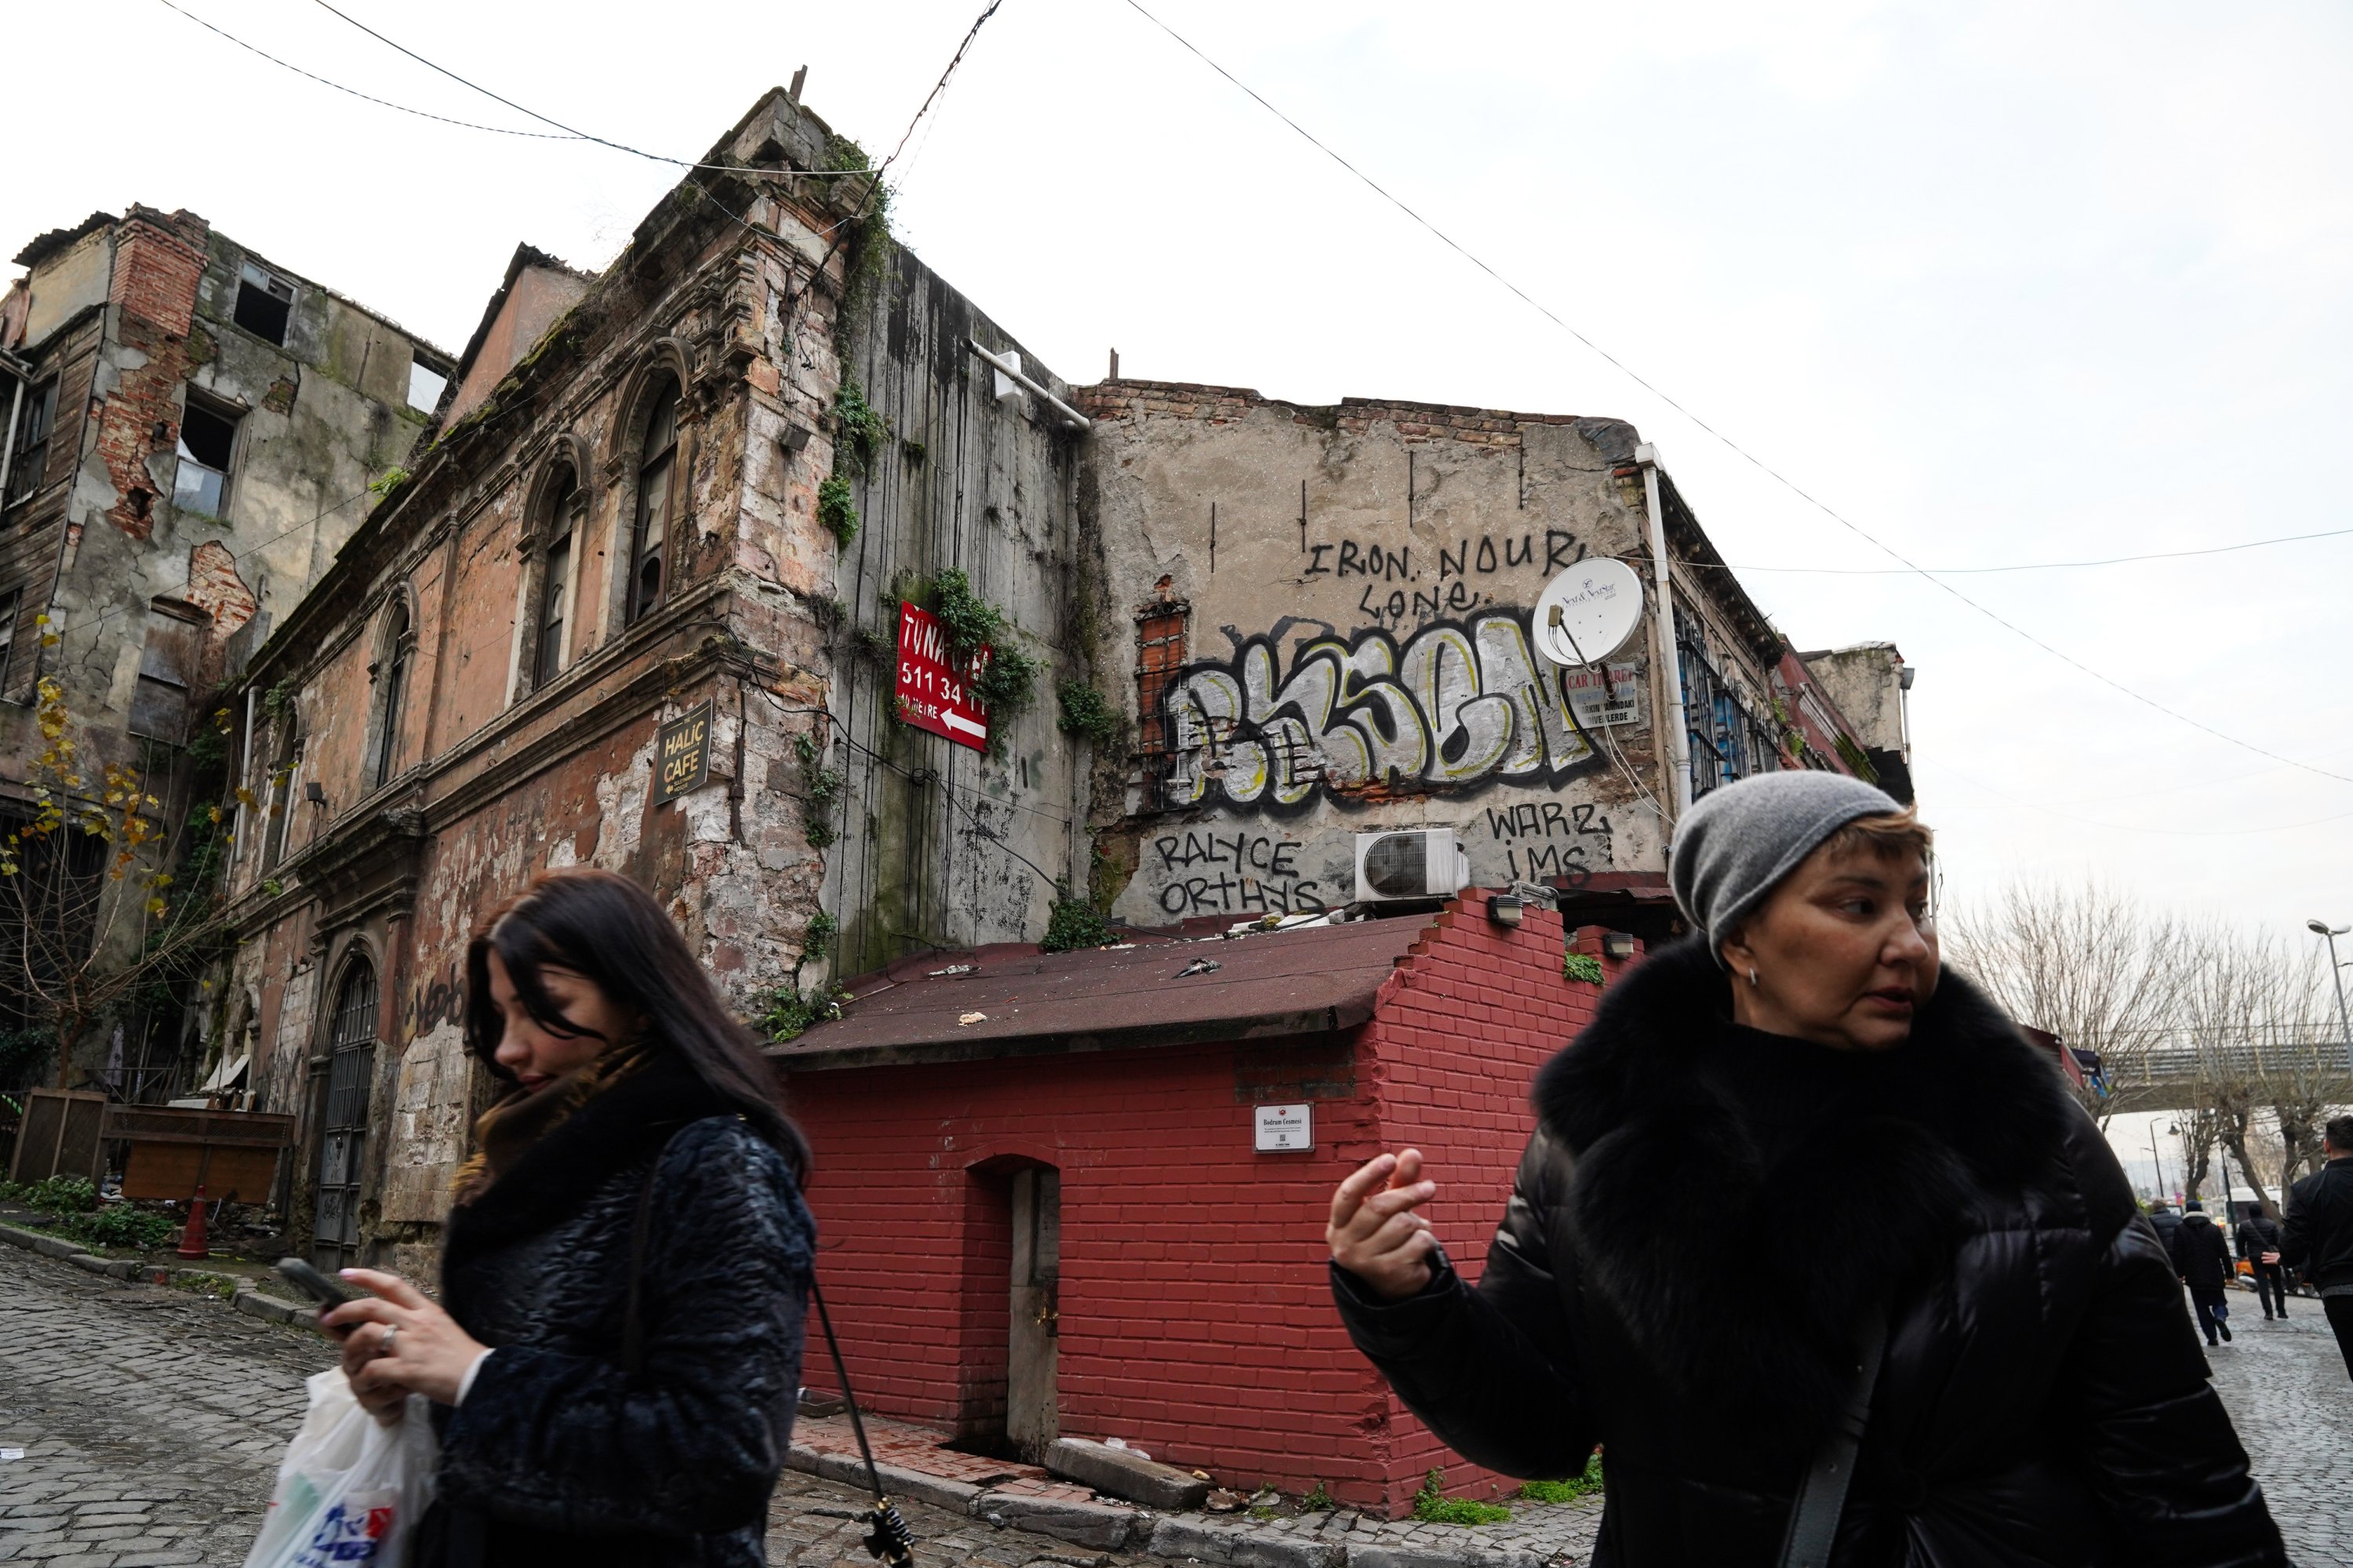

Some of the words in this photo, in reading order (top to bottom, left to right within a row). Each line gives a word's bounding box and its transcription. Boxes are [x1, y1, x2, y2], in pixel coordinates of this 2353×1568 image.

[904, 612, 945, 666] TUNA
[902, 661, 933, 693] 511
[940, 677, 962, 705] 34
[1566, 673, 1589, 690] CAR
[664, 749, 699, 783] CAFE
